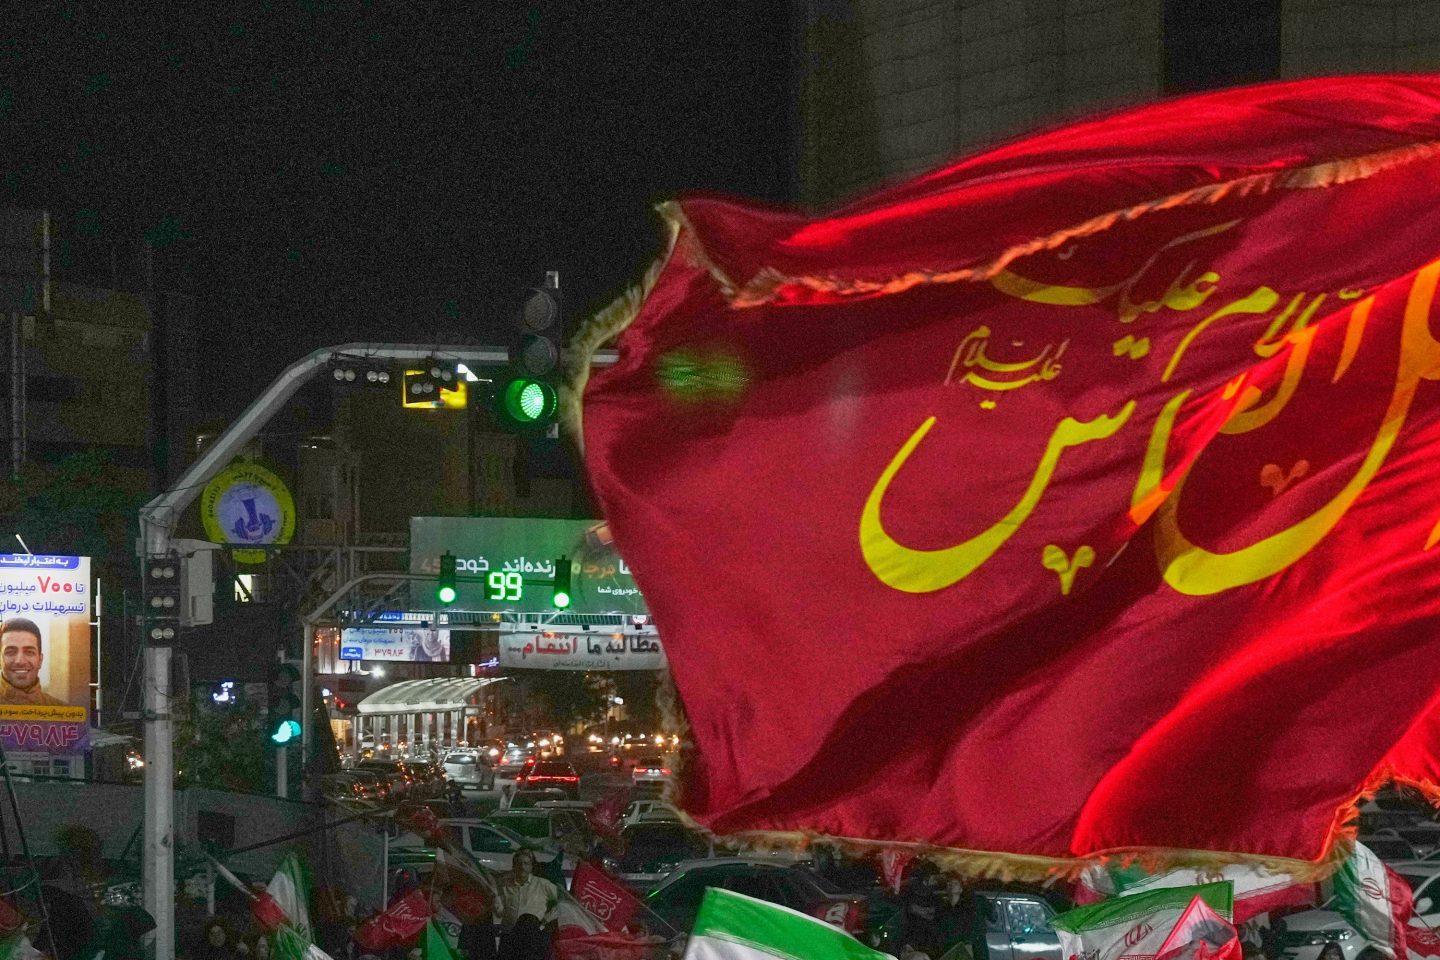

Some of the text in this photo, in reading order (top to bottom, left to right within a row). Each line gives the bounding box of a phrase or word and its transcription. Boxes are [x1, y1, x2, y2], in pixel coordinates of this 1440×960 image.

[502, 557, 556, 577] رنده‌اند
[37, 575, 73, 593] ۷۰۰
[75, 583, 85, 593] تا
[489, 572, 522, 600] 99
[32, 601, 85, 615] تسهیلات
[587, 636, 602, 654] ما
